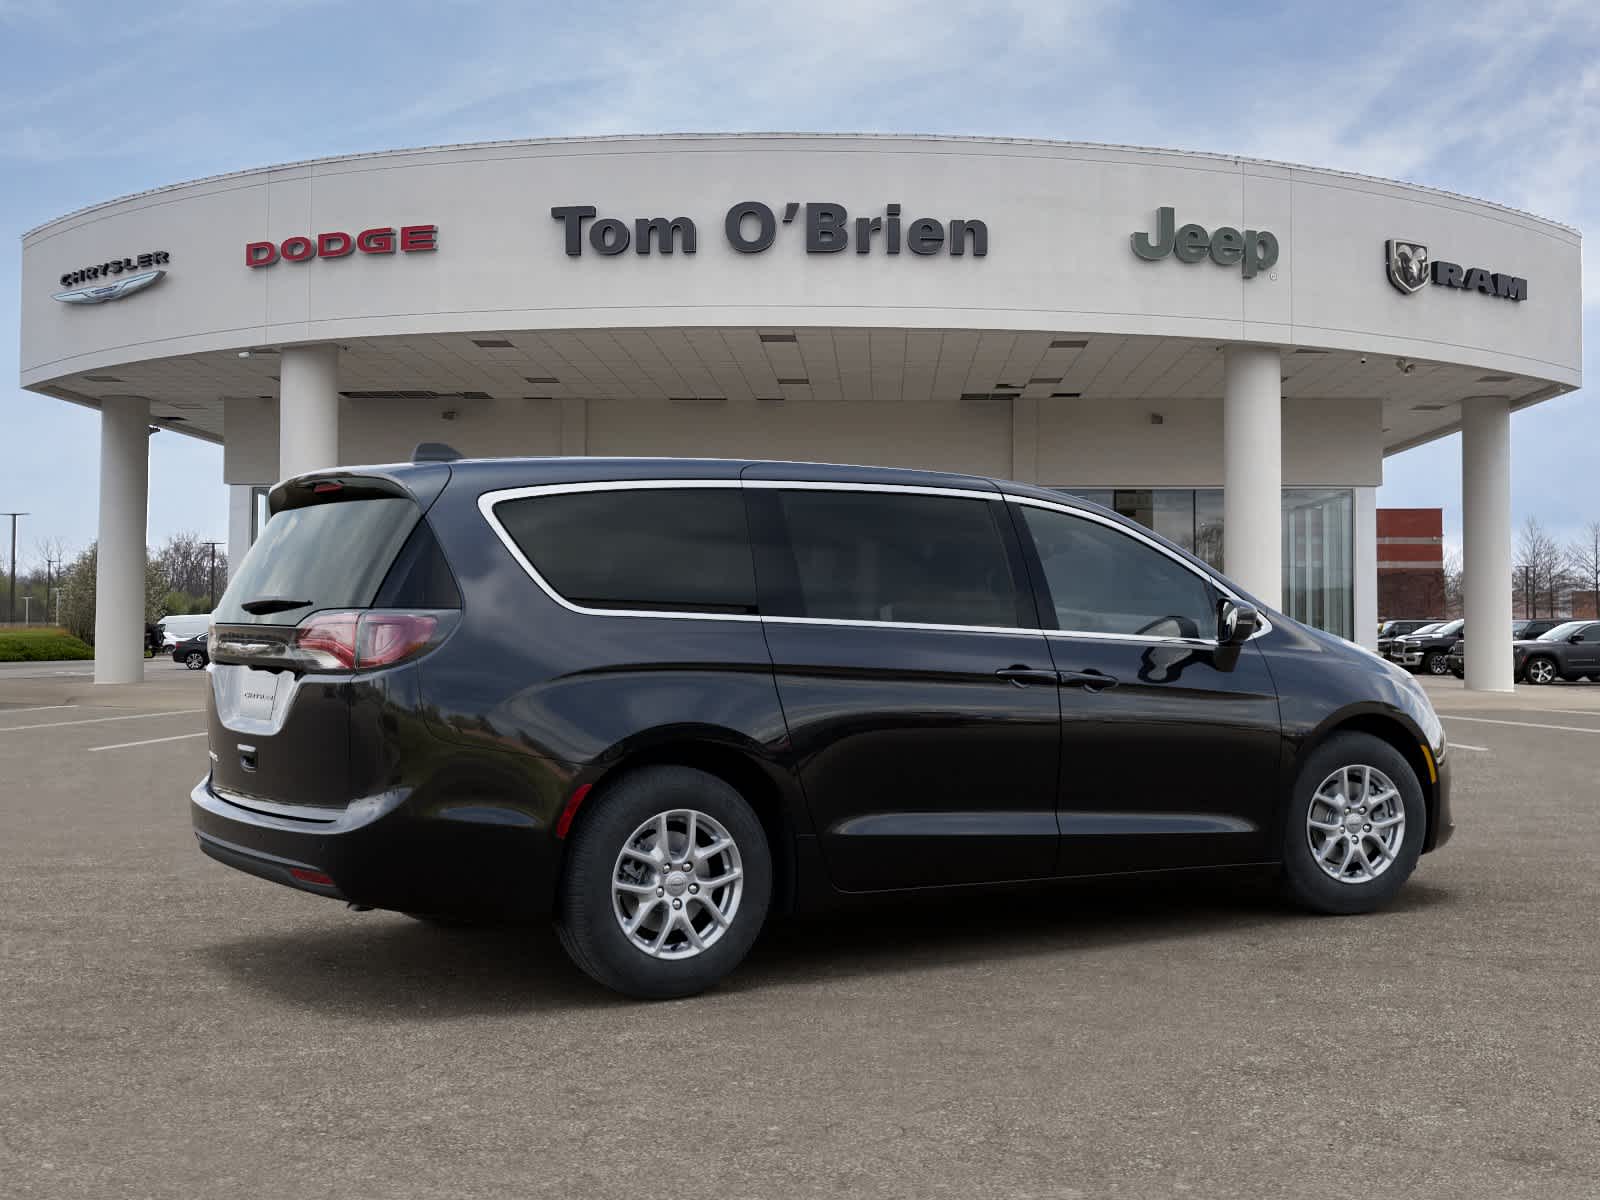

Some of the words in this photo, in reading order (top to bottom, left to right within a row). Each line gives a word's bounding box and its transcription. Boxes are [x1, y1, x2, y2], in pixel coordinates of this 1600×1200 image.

[245, 225, 438, 268] DODGE
[551, 206, 697, 256] Tom
[725, 201, 988, 257] O'Brien
[1130, 207, 1279, 278] Jeep
[60, 250, 170, 287] CHRYSLER
[1431, 261, 1527, 301] RAM
